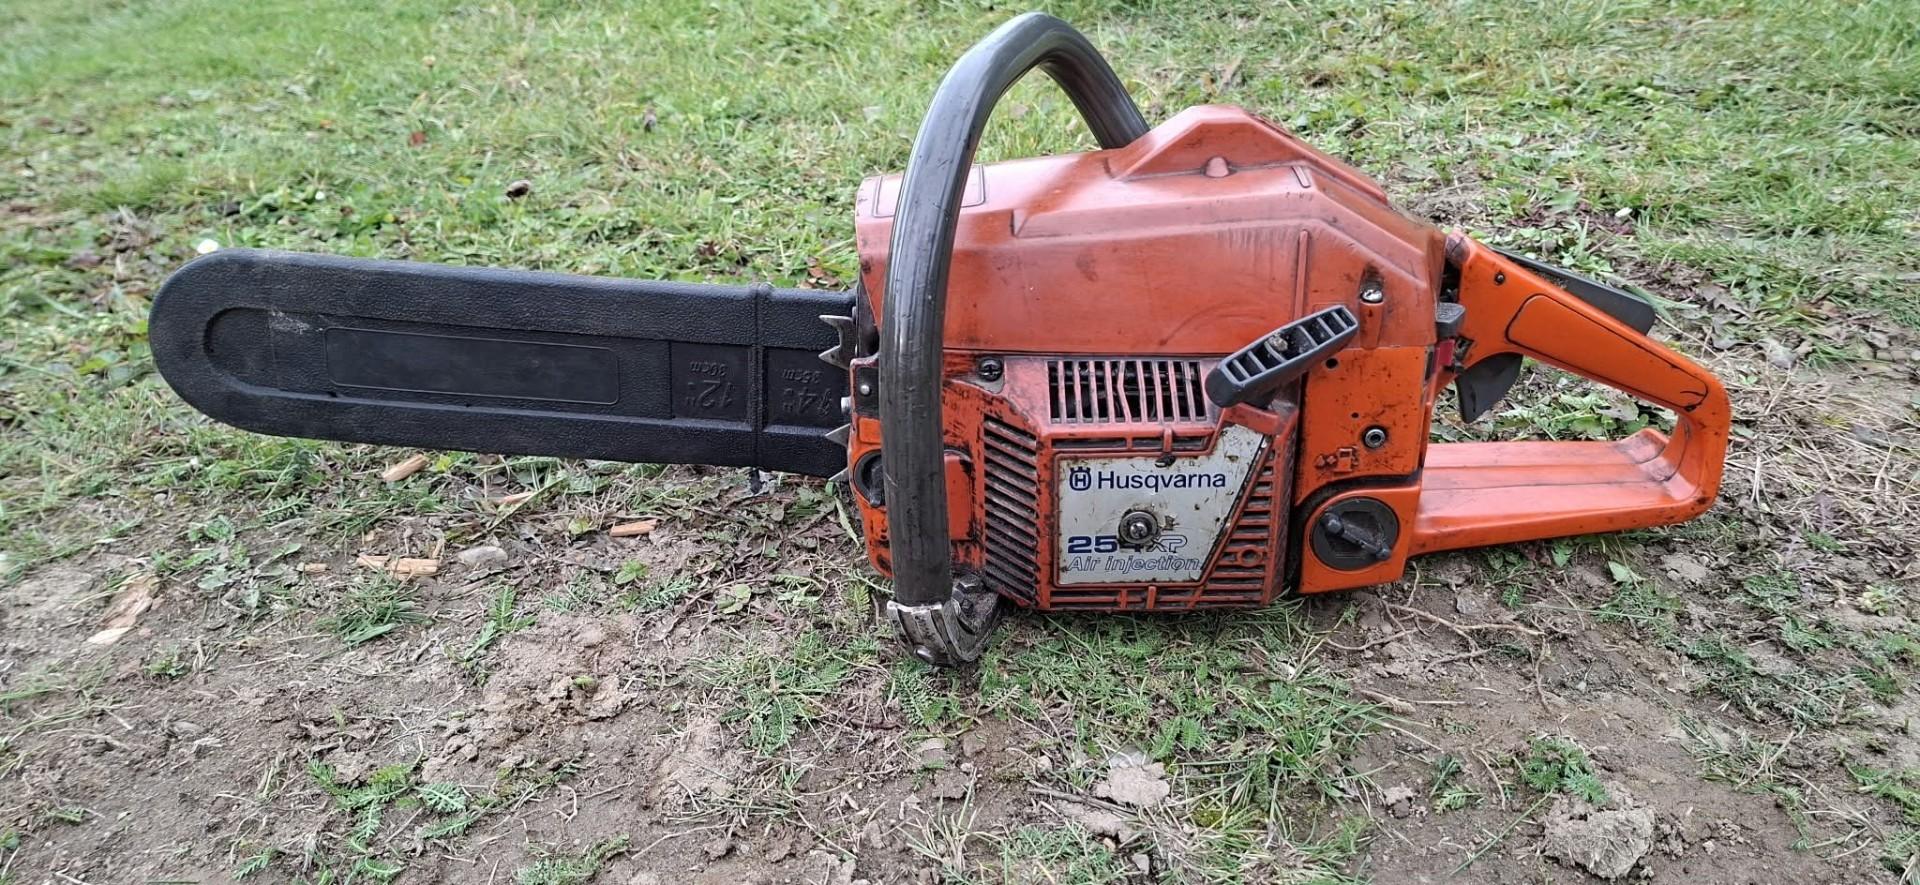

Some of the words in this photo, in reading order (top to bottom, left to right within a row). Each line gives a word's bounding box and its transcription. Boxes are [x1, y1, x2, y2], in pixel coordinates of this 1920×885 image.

[1098, 471, 1226, 493] Husqvarna
[1067, 556, 1101, 571] Air
[1104, 555, 1200, 575] injection
